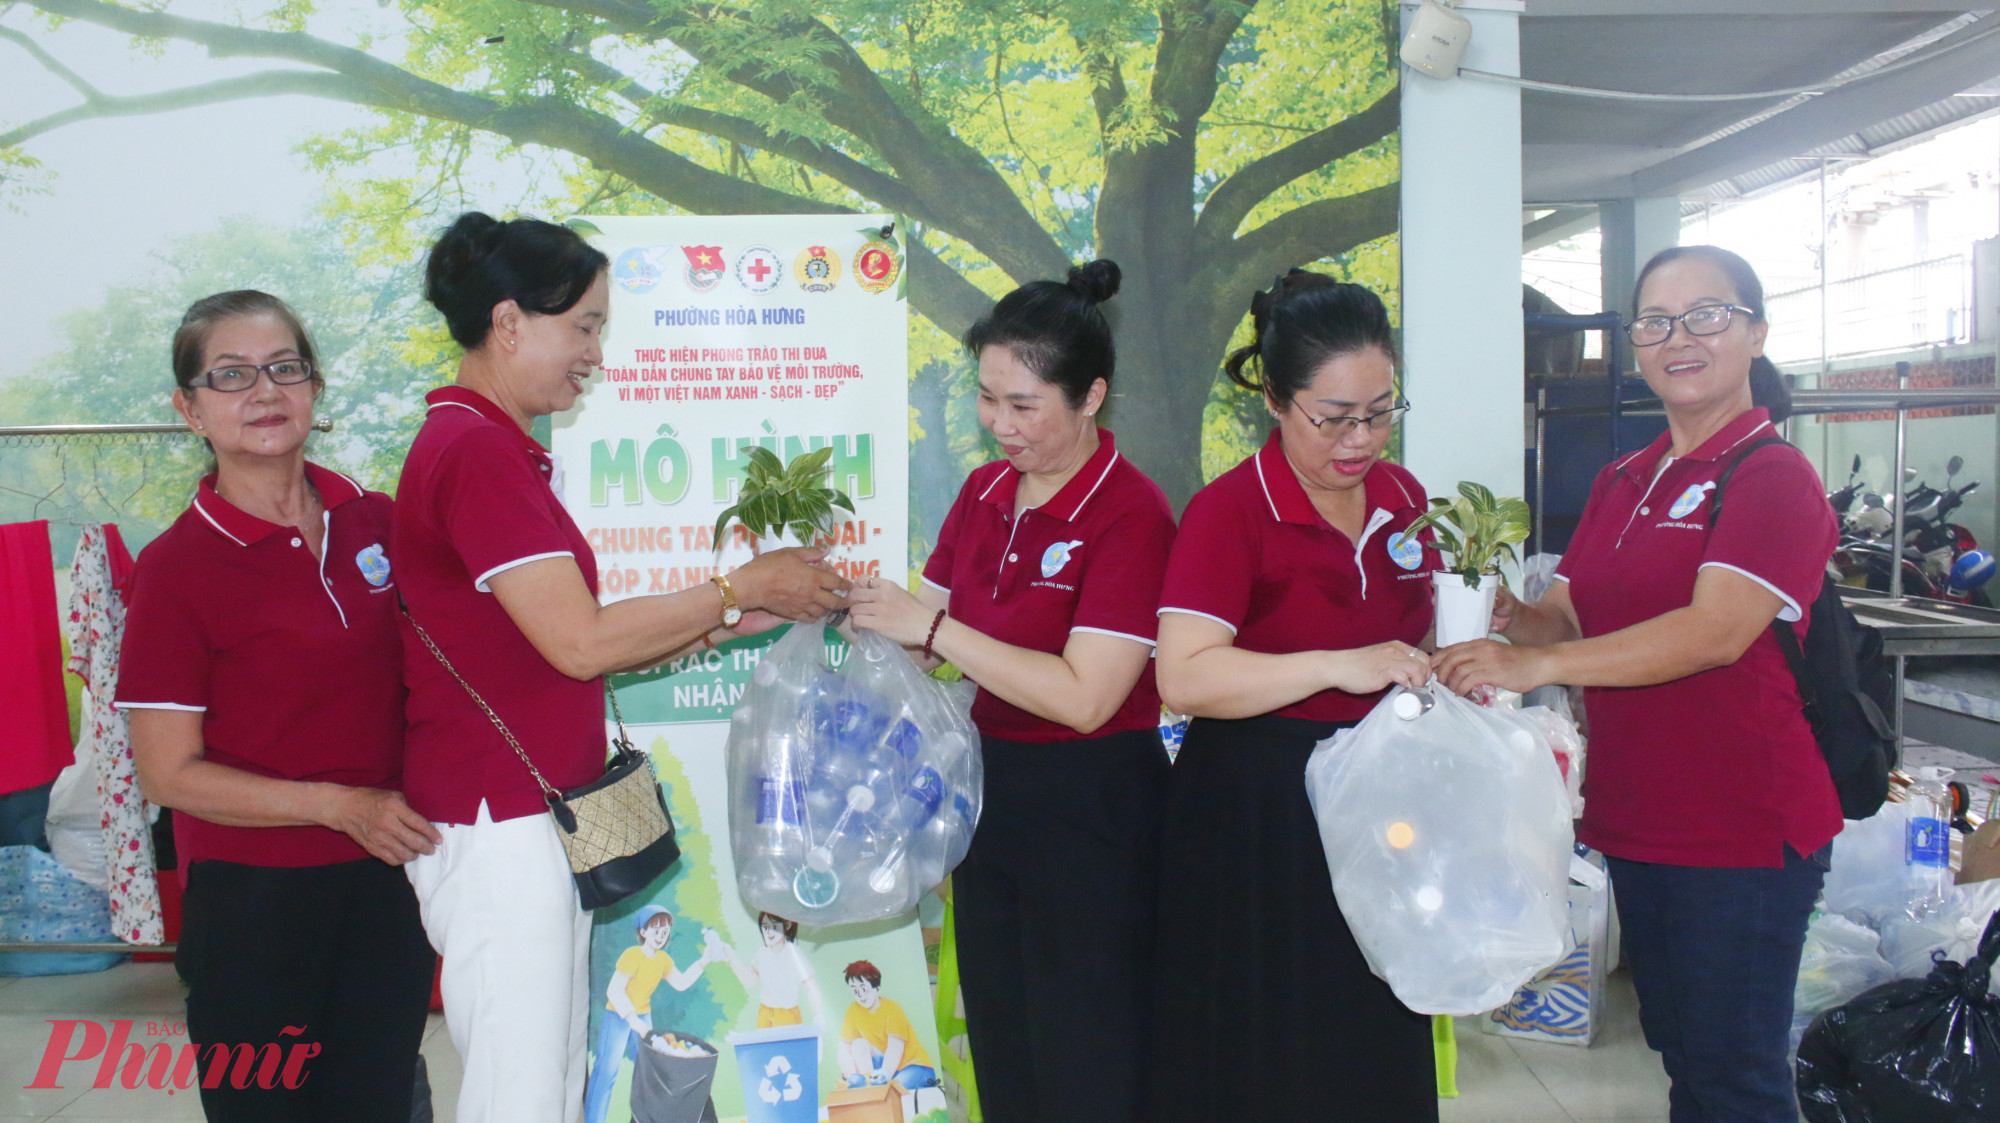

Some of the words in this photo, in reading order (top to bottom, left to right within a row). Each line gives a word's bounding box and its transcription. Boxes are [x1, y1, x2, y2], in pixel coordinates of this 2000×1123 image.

[655, 305, 720, 326] PHƯỜNG
[725, 305, 757, 325] HÒA
[762, 307, 806, 325] HƯNG
[635, 348, 666, 365] THỰC
[670, 346, 698, 365] HIỆN
[702, 347, 744, 362] PHONG
[747, 345, 778, 362] TRÀO
[781, 347, 800, 361] THI
[803, 347, 828, 361] ĐUA
[641, 363, 667, 382] DÂN
[671, 366, 713, 381] CHUNG
[716, 366, 735, 381] TAY
[739, 362, 764, 380] BẢO
[767, 363, 782, 383] VỆ
[786, 364, 808, 380] MÔI
[812, 362, 864, 380] TRƯỜNG,
[618, 385, 631, 401] VÌ
[634, 385, 660, 403] MỘT
[664, 384, 690, 403] VIỆT
[693, 386, 722, 400] NAM
[725, 386, 758, 400] XANH
[770, 384, 801, 402] SẠCH
[590, 423, 692, 506] MÔ
[587, 526, 671, 554] CHUNG
